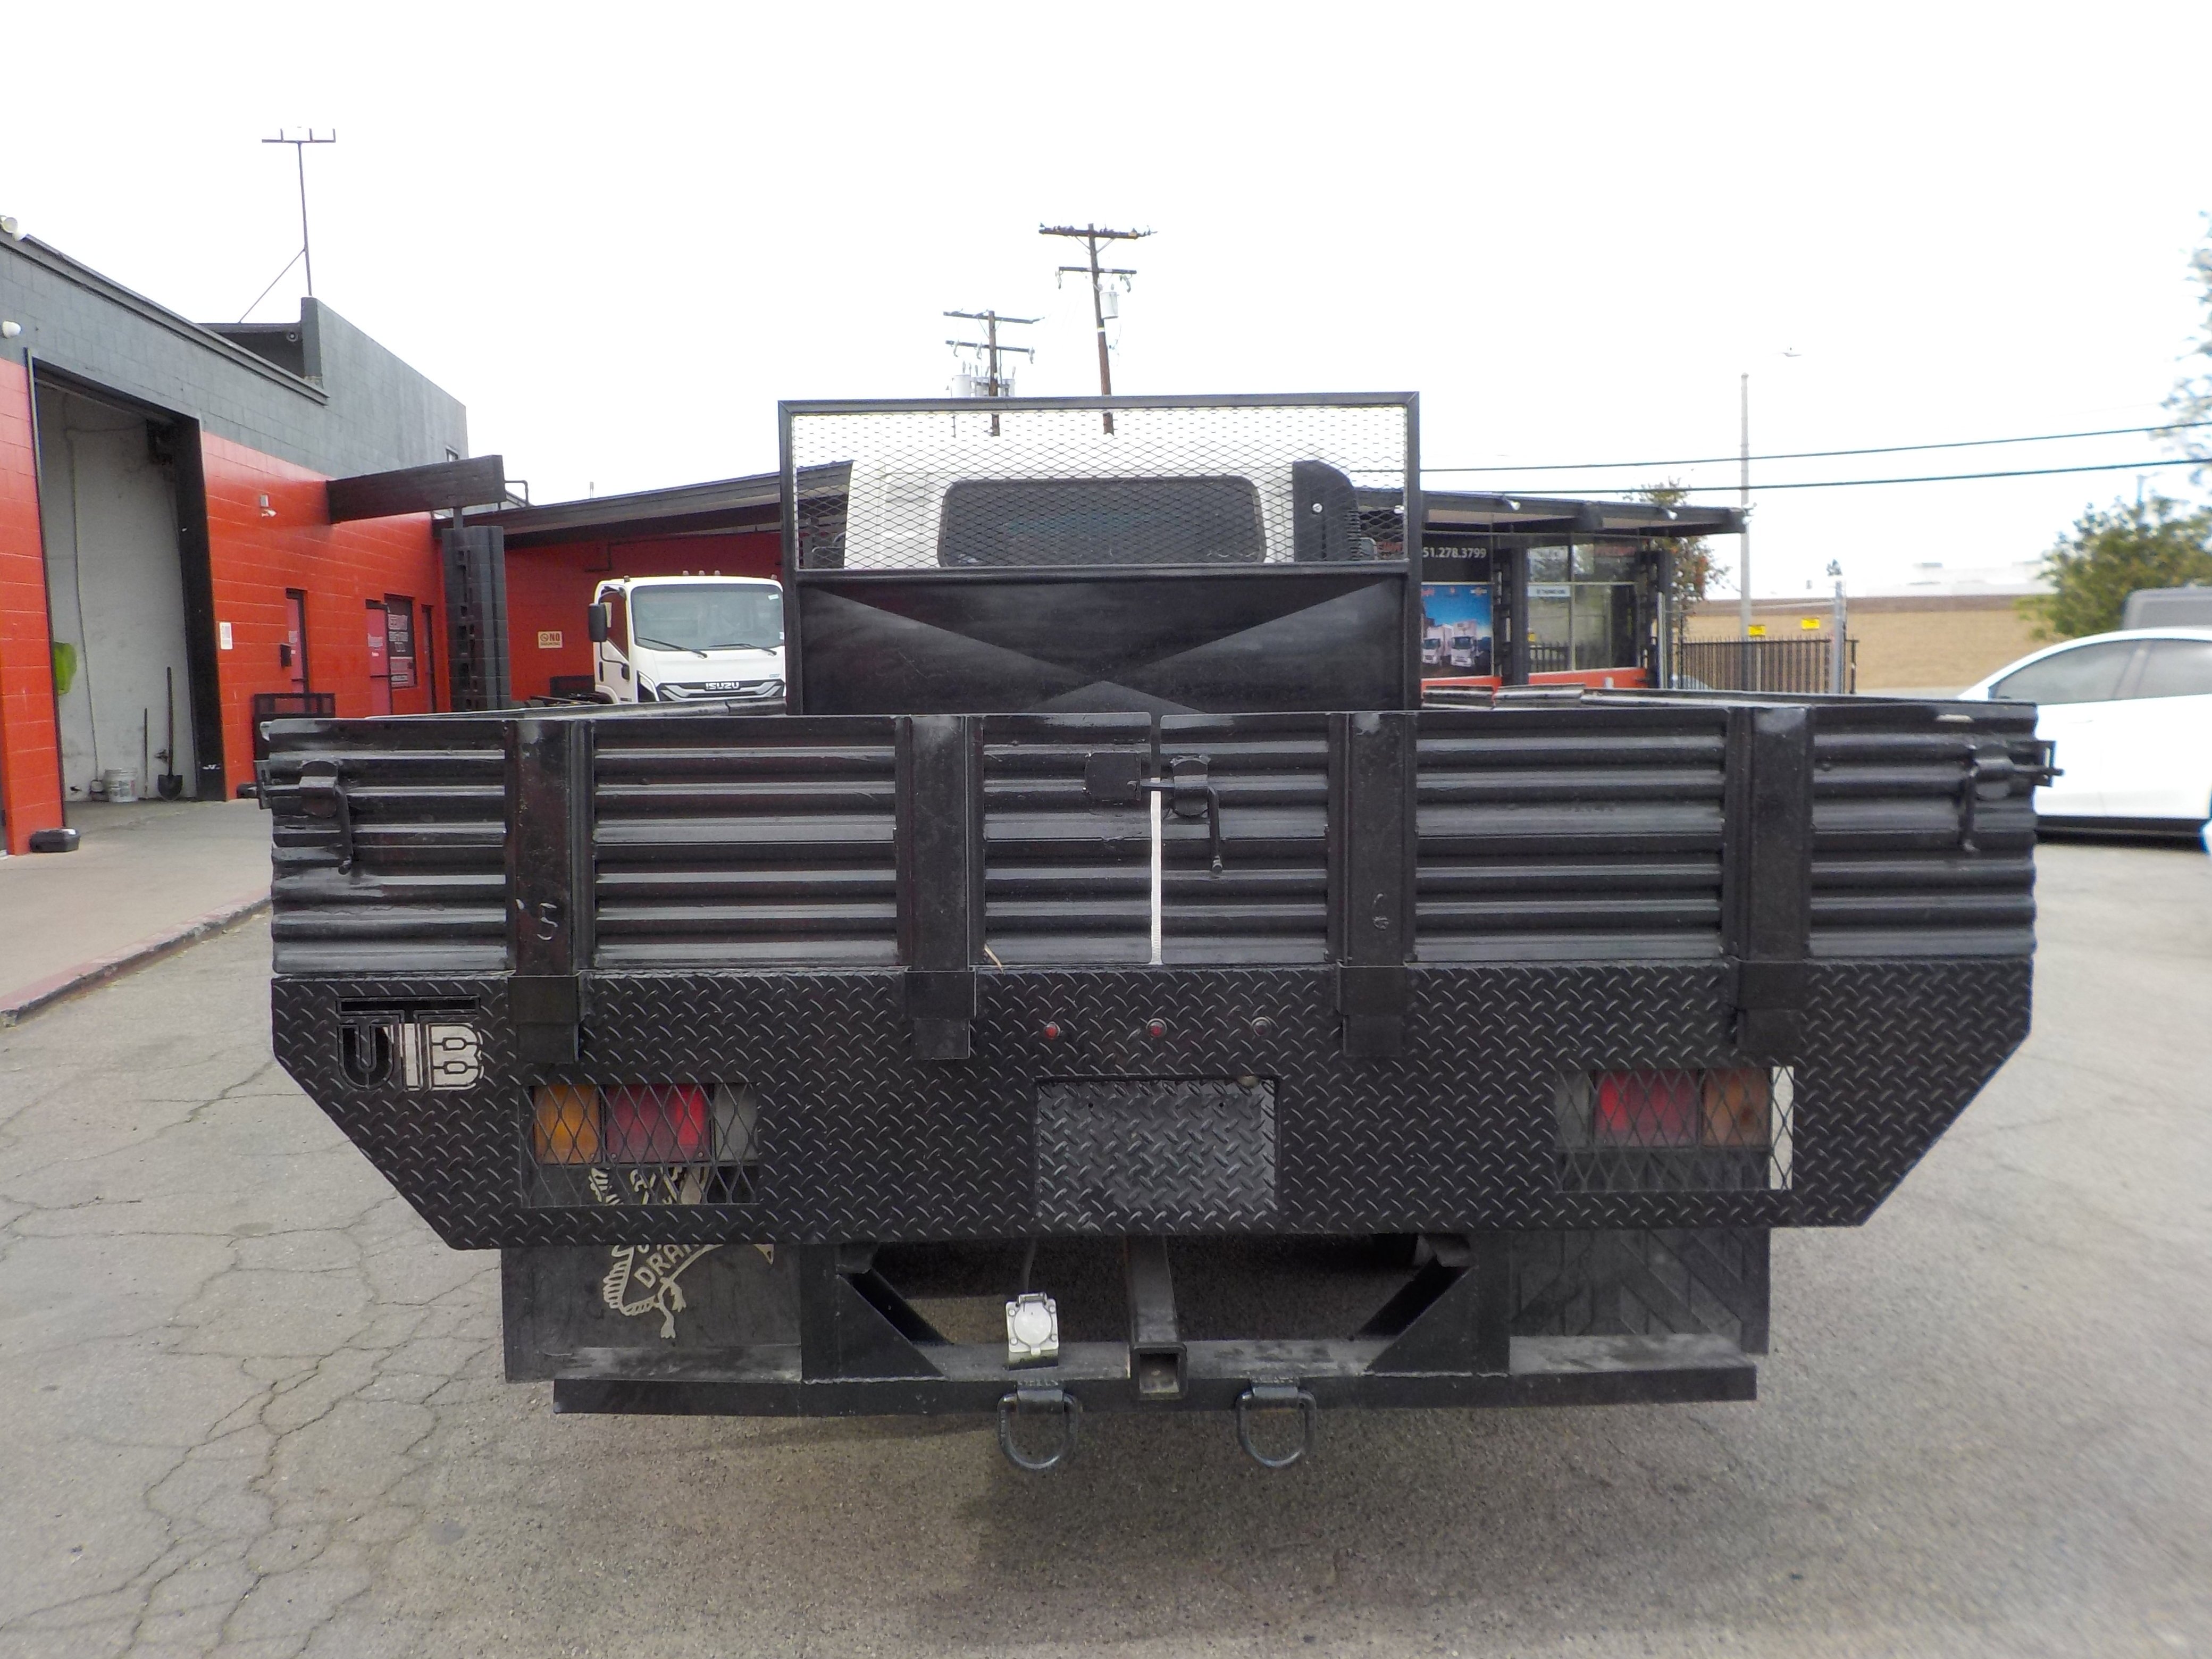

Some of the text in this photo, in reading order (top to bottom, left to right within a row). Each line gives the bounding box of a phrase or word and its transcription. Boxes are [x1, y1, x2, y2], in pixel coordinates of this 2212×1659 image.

[1422, 546, 1487, 558] 51.278.3799
[549, 633, 560, 641] NO
[706, 682, 740, 690] ISUZU
[633, 1244, 693, 1289] DRA
